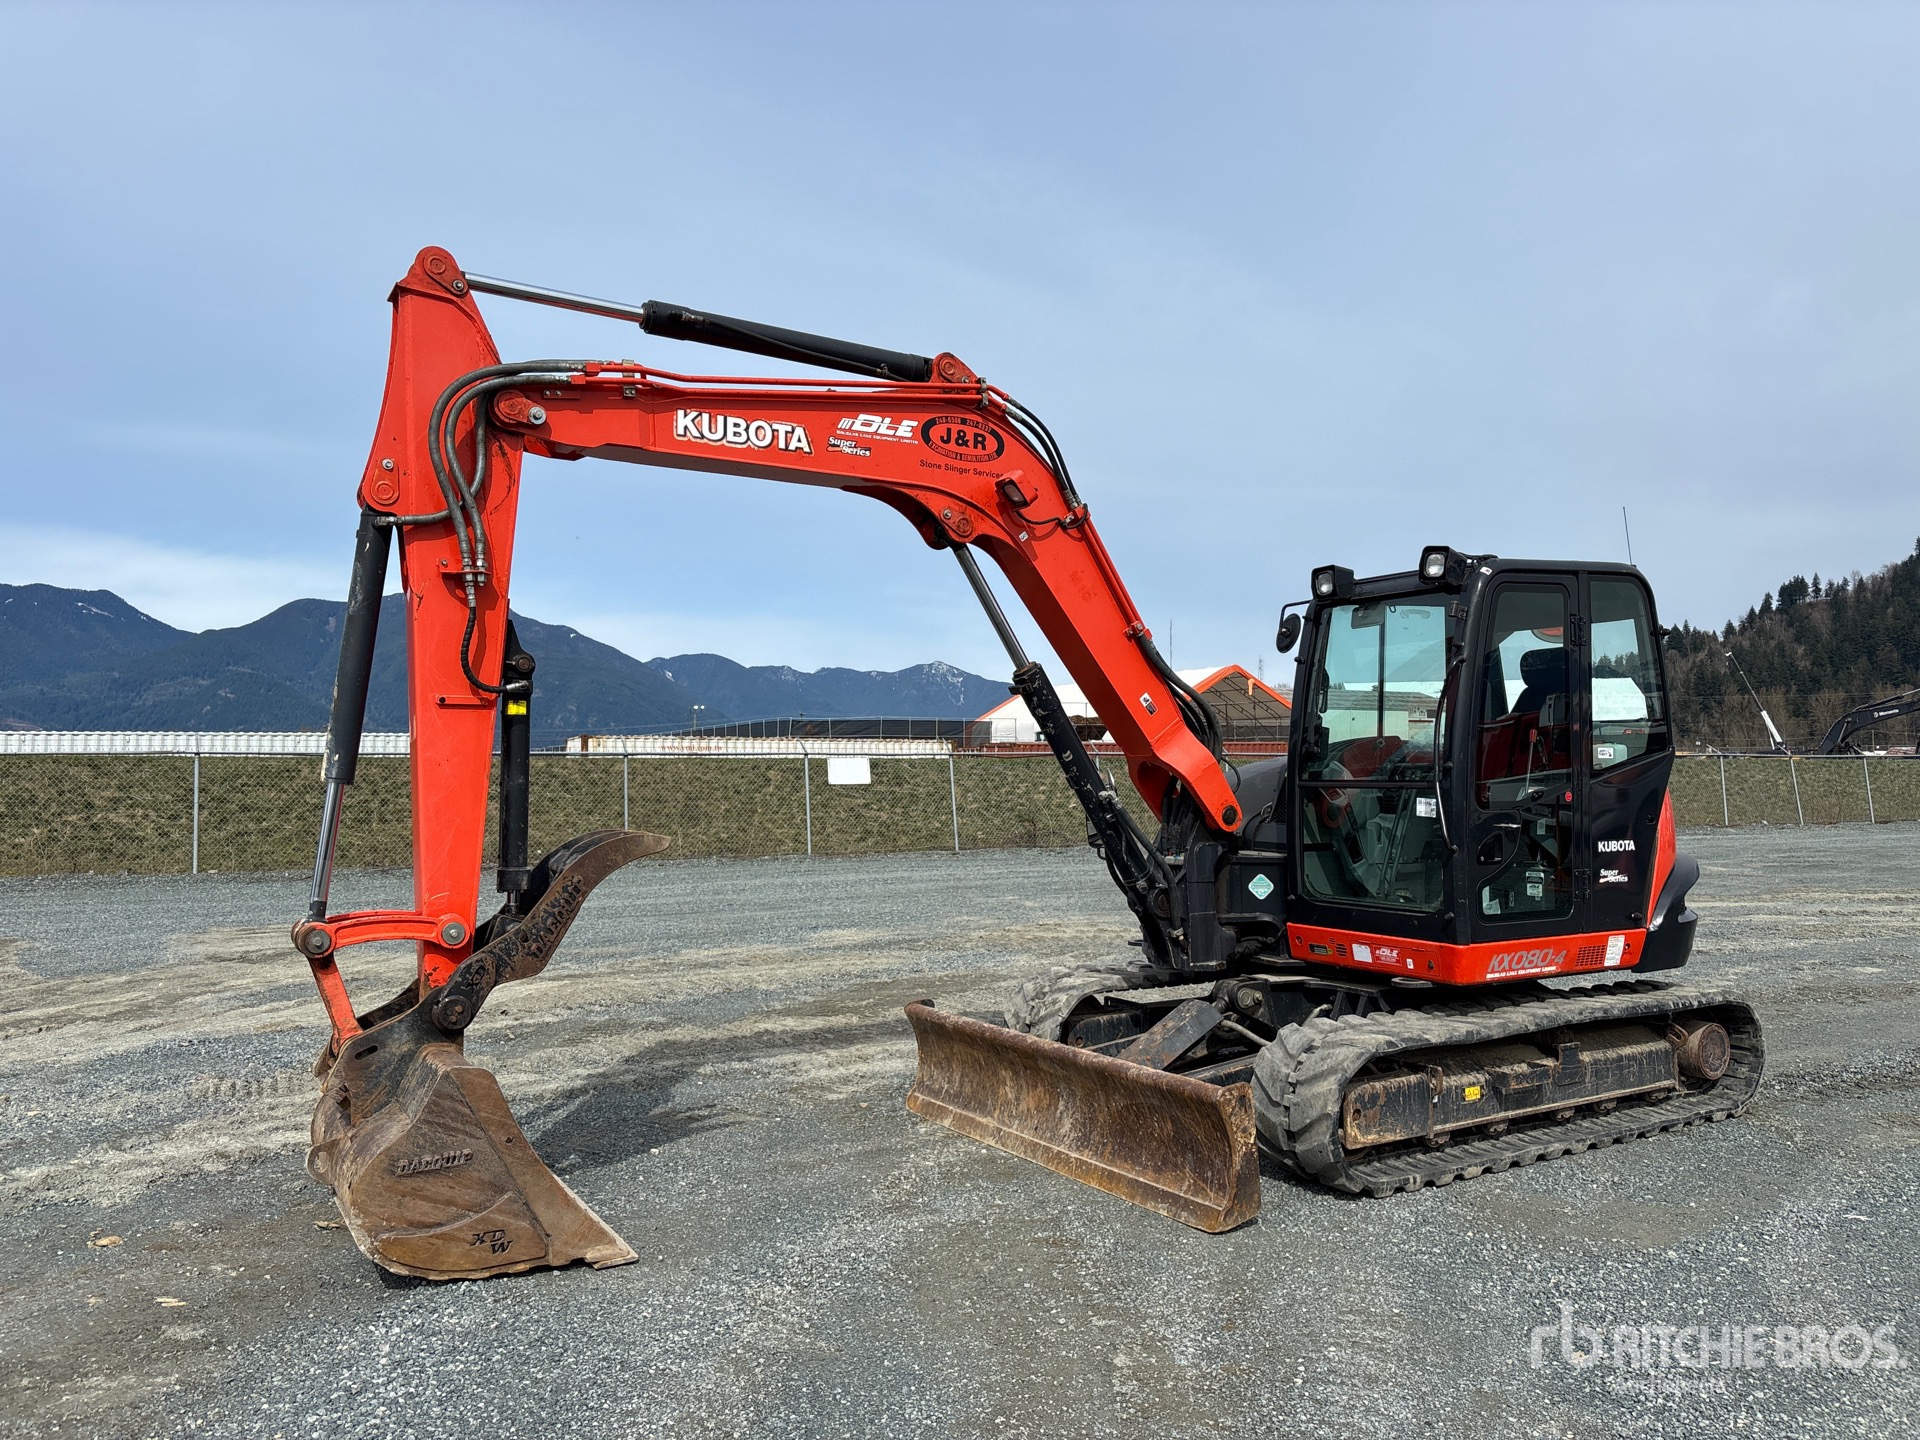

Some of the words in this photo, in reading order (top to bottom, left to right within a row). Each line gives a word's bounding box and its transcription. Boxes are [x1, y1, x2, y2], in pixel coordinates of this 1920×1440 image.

[676, 408, 813, 455] KUBOTA
[828, 436, 857, 448] Super
[940, 427, 987, 451] J&R
[841, 445, 871, 457] Series
[920, 459, 942, 471] Stone
[944, 463, 971, 475] Slinger
[1597, 840, 1636, 853] KUBOTA
[1600, 868, 1619, 877] Super
[1488, 948, 1568, 972] KX080-4
